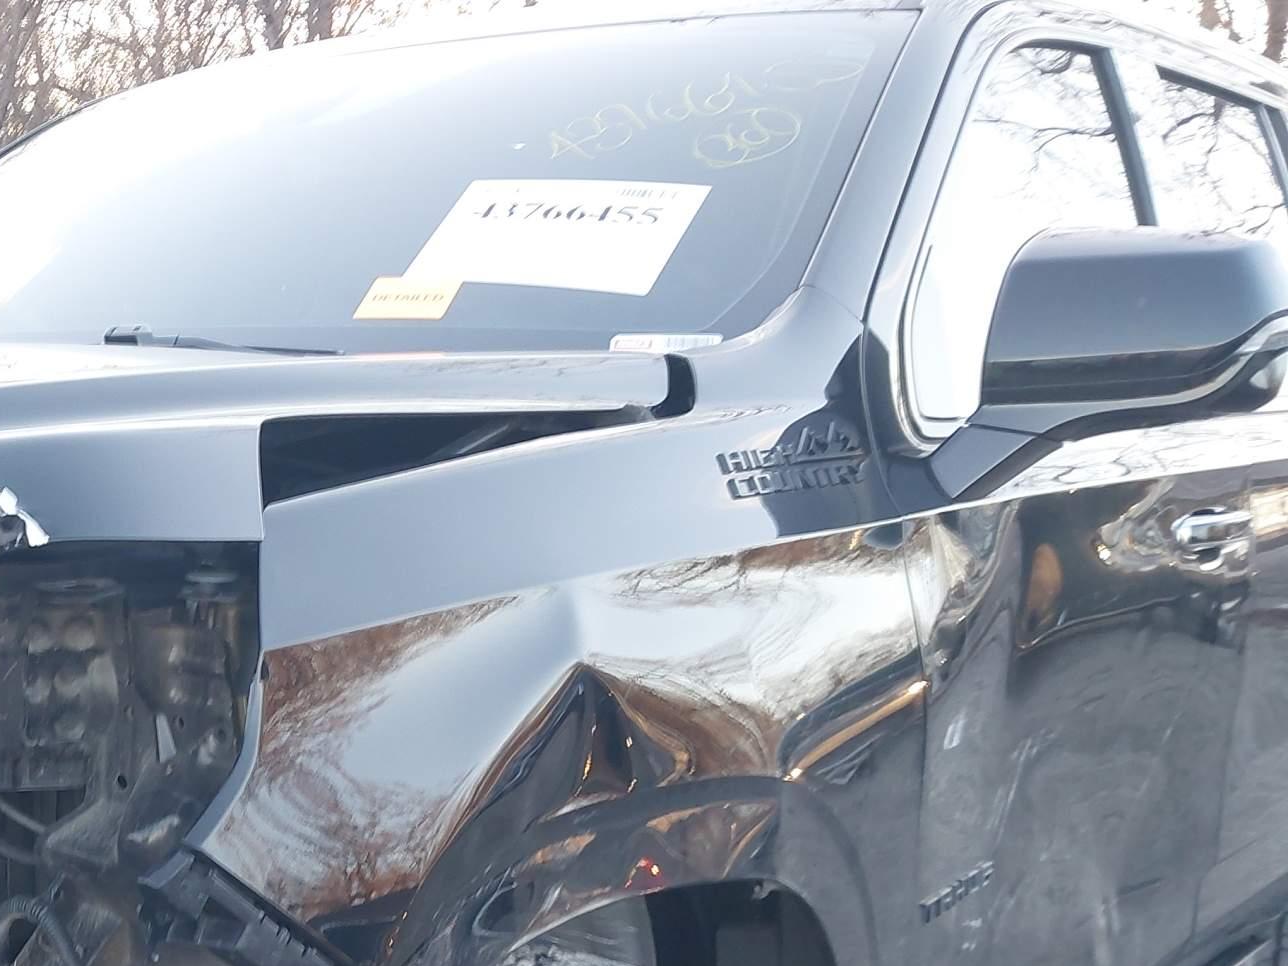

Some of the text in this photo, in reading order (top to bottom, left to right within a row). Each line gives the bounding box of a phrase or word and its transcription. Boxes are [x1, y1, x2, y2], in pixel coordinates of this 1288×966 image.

[472, 201, 665, 225] 43766455
[714, 443, 795, 475] HIGH
[725, 461, 866, 500] COUNTRY
